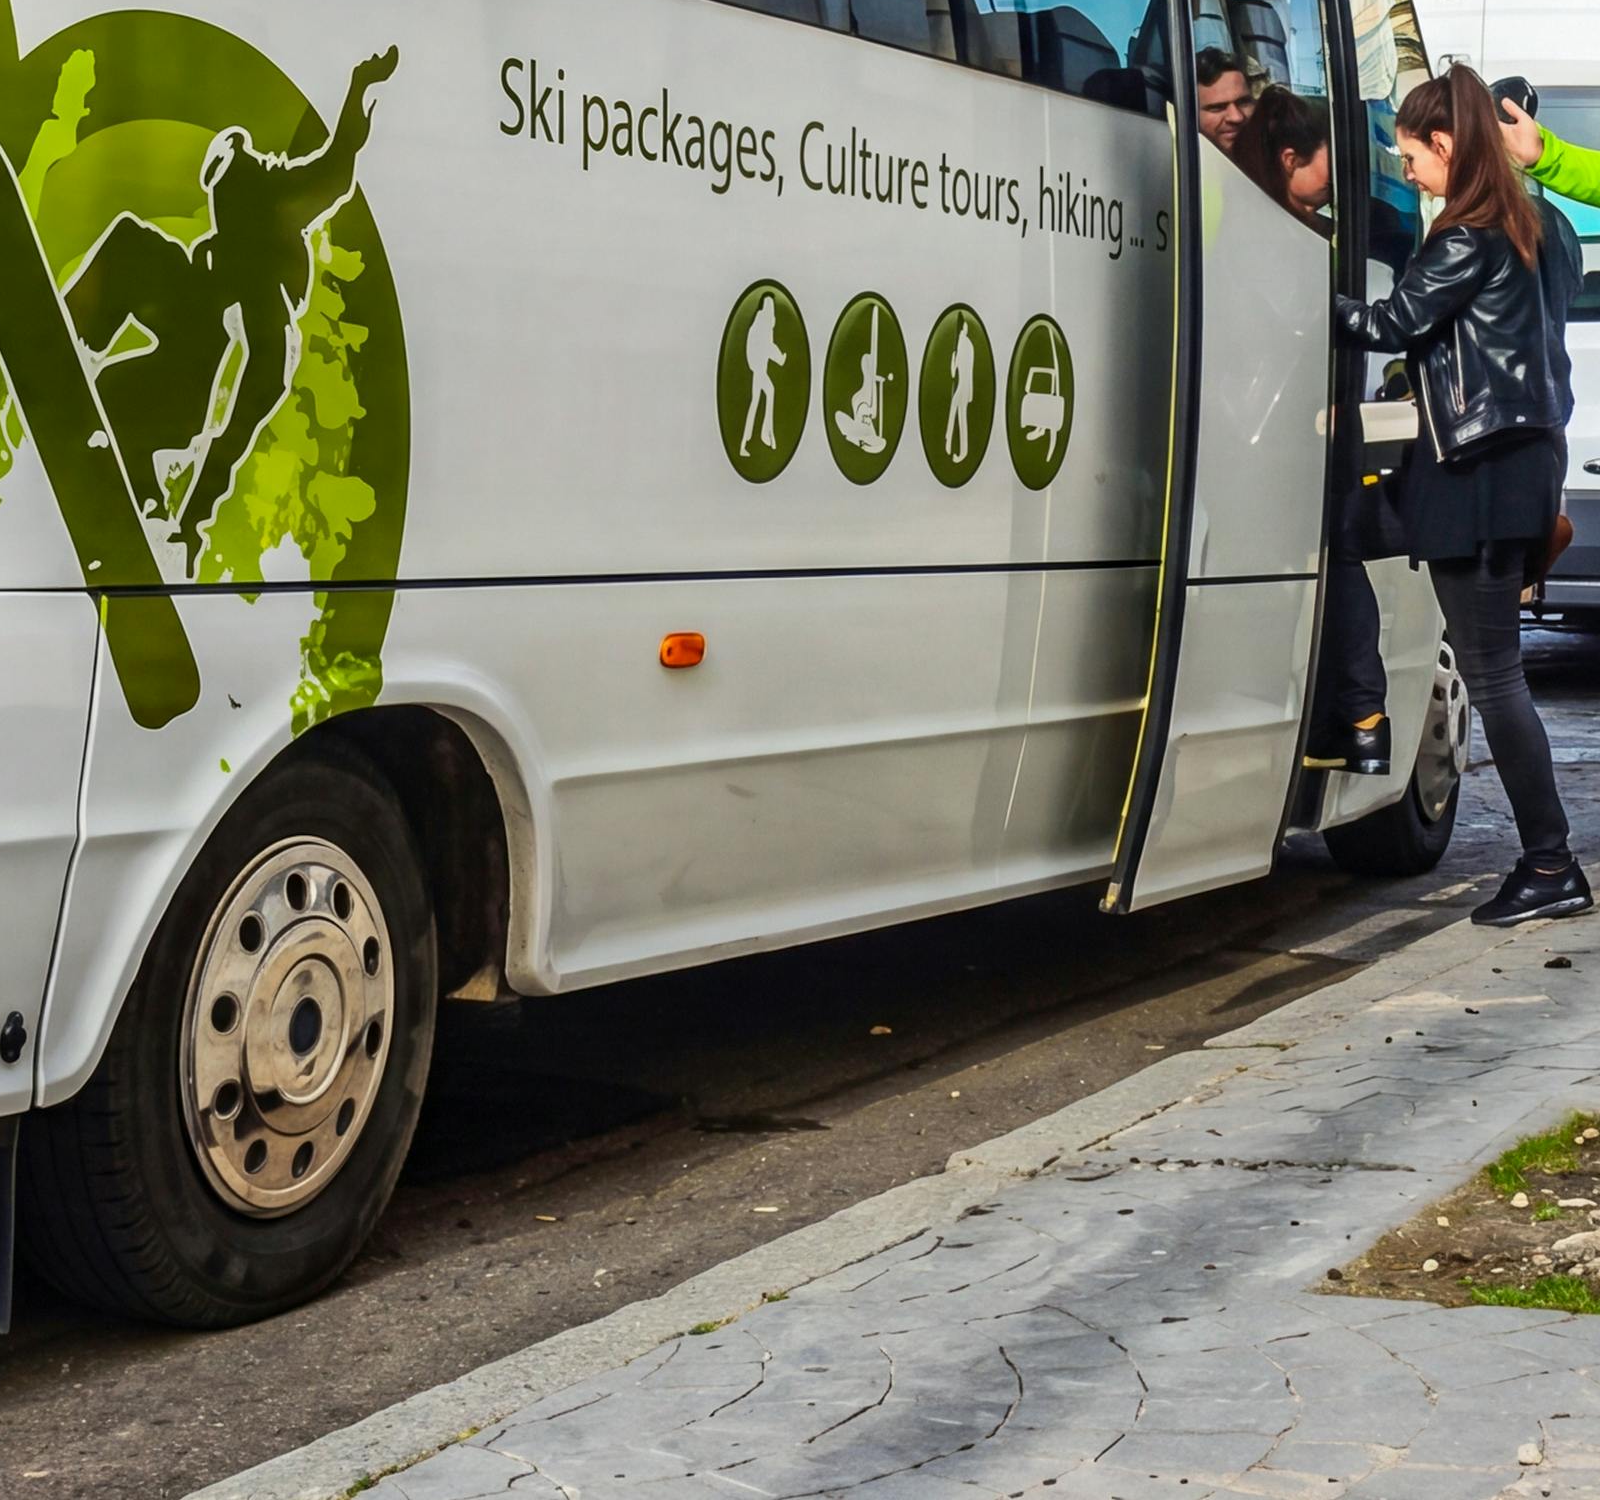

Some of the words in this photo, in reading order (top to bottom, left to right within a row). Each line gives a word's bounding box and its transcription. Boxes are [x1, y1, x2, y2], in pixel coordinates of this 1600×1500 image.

[499, 57, 566, 145] Ski
[582, 87, 784, 197] packages,
[800, 121, 929, 210] Culture
[939, 153, 1028, 239] tours,
